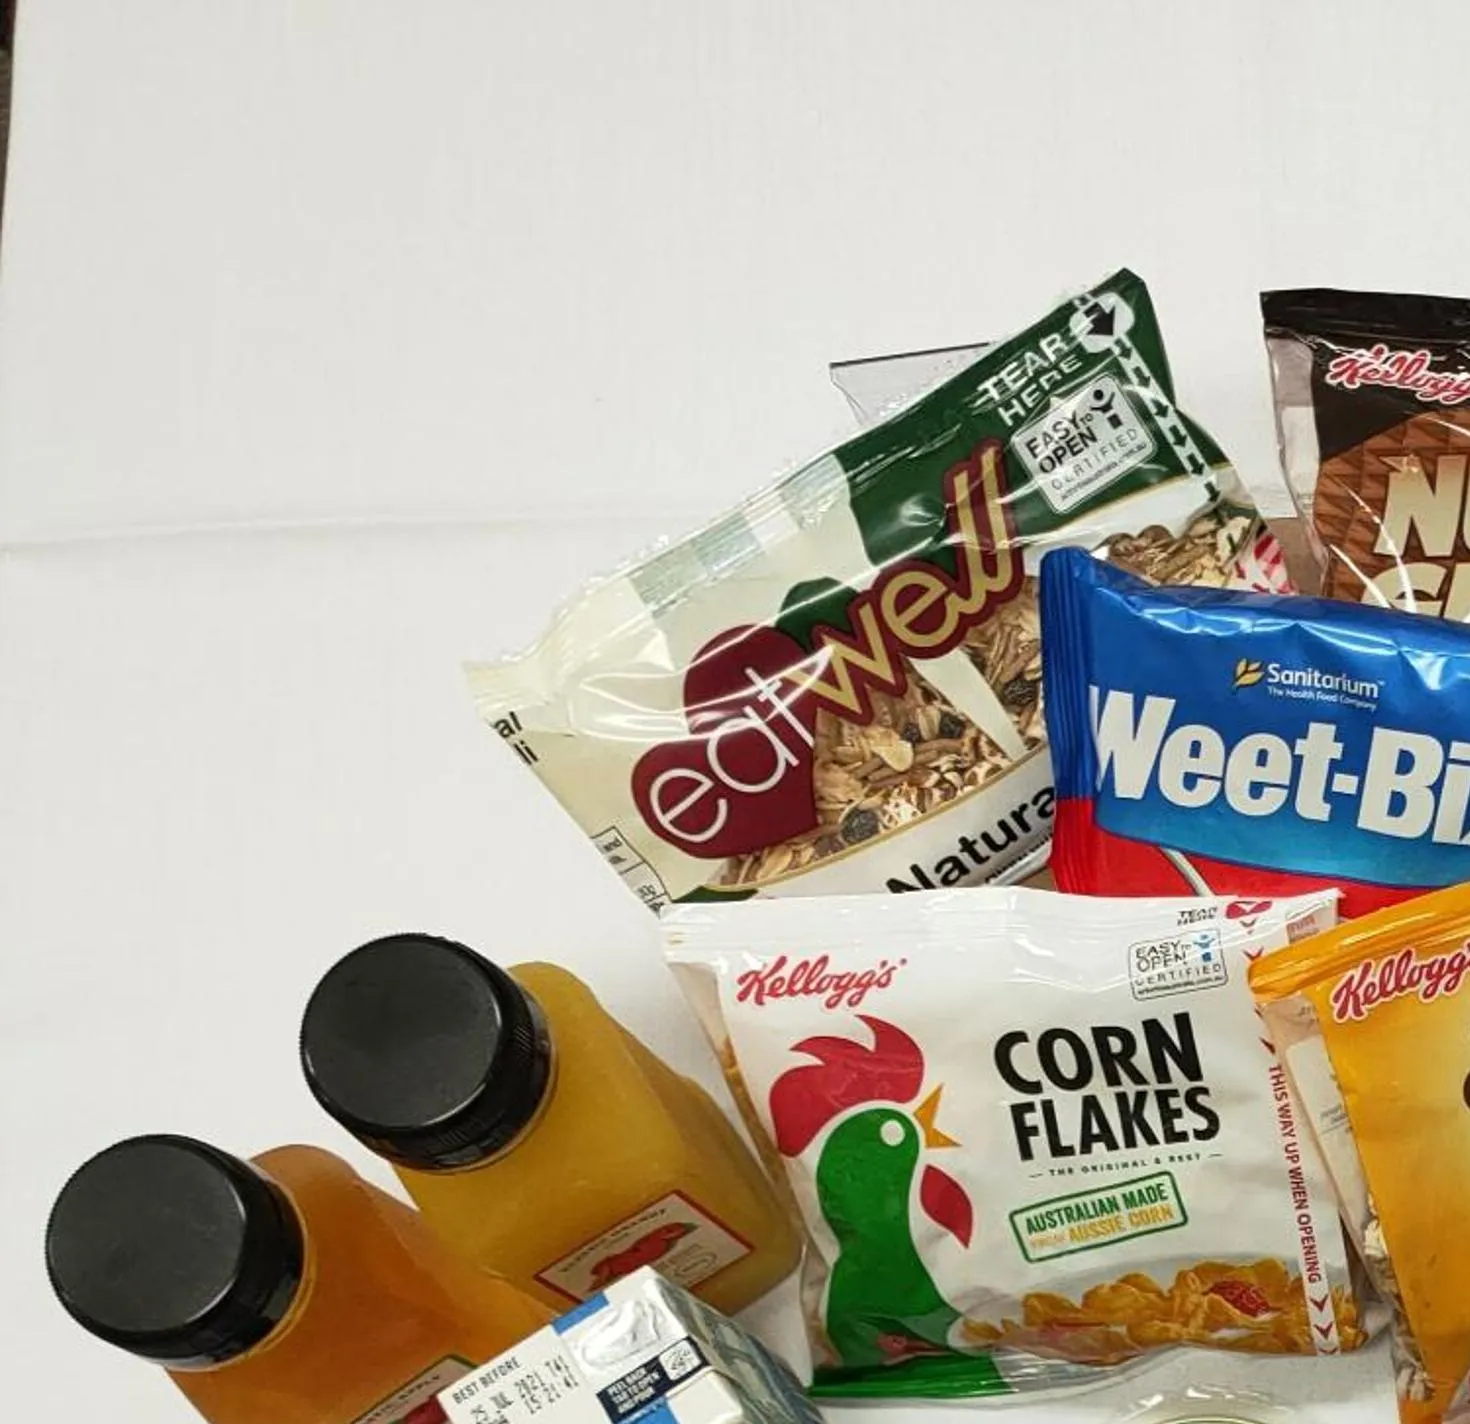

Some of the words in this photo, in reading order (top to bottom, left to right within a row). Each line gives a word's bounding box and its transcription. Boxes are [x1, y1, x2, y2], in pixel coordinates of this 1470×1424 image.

[977, 333, 1068, 400] TEAR
[998, 355, 1082, 426] HERE
[1025, 412, 1080, 459] EASY
[1040, 428, 1097, 473] OPEN
[1267, 663, 1378, 698] Sanitarium
[886, 787, 1054, 893] Natura
[737, 955, 897, 1009] Kellogg's
[994, 1012, 1204, 1096] CORN
[1009, 1086, 1220, 1162] FLAKES
[1026, 1197, 1120, 1235] AUSTRALIAN
[1122, 1183, 1169, 1210] MADE
[1069, 1218, 1125, 1243] AUSSIE
[1129, 1205, 1175, 1227] CORN
[452, 1380, 482, 1405] BEST
[482, 1356, 520, 1388] BEFORE
